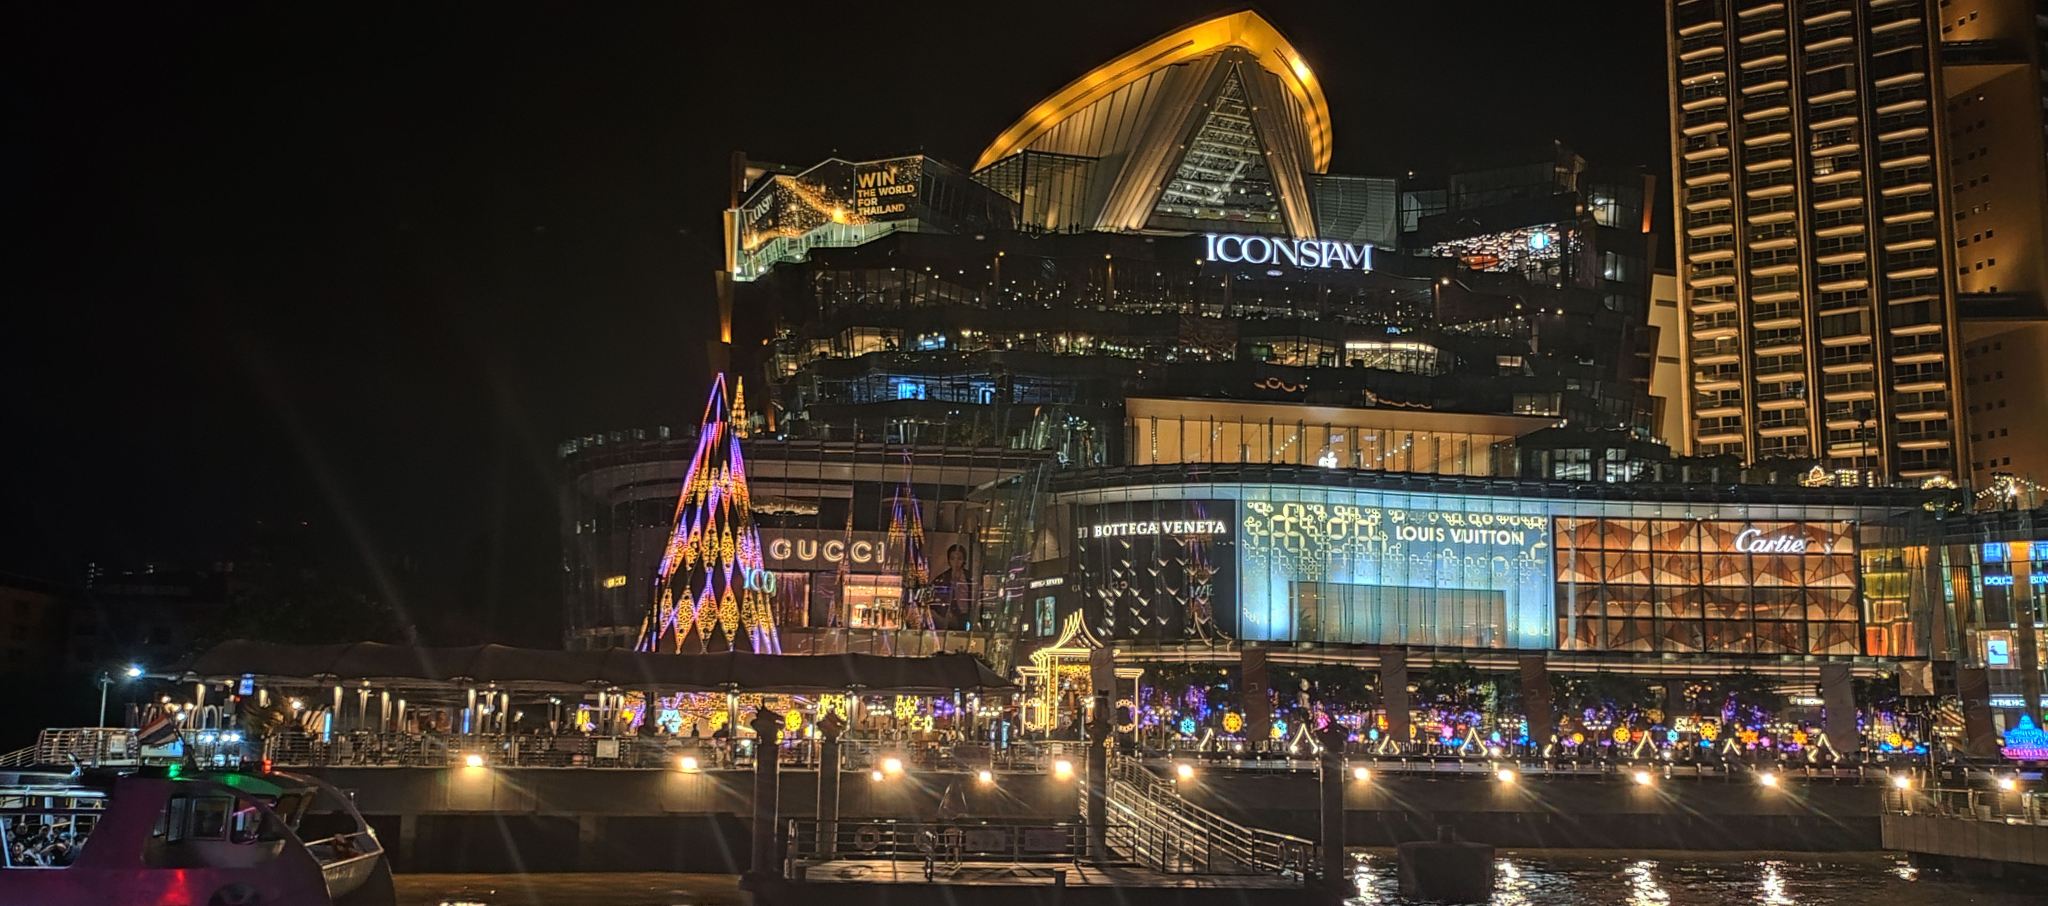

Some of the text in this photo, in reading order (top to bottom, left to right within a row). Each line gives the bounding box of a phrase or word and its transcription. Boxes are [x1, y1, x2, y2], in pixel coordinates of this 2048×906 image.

[858, 171, 896, 188] WIN
[857, 184, 915, 198] THE WORLD
[857, 197, 878, 208] FOR
[857, 203, 906, 216] THAILAND
[1206, 233, 1374, 271] ICONSIAM
[1093, 519, 1227, 538] BOTTEGA VENETA
[1396, 525, 1525, 546] LOUIS VUITTON
[769, 538, 885, 564] GUCCI
